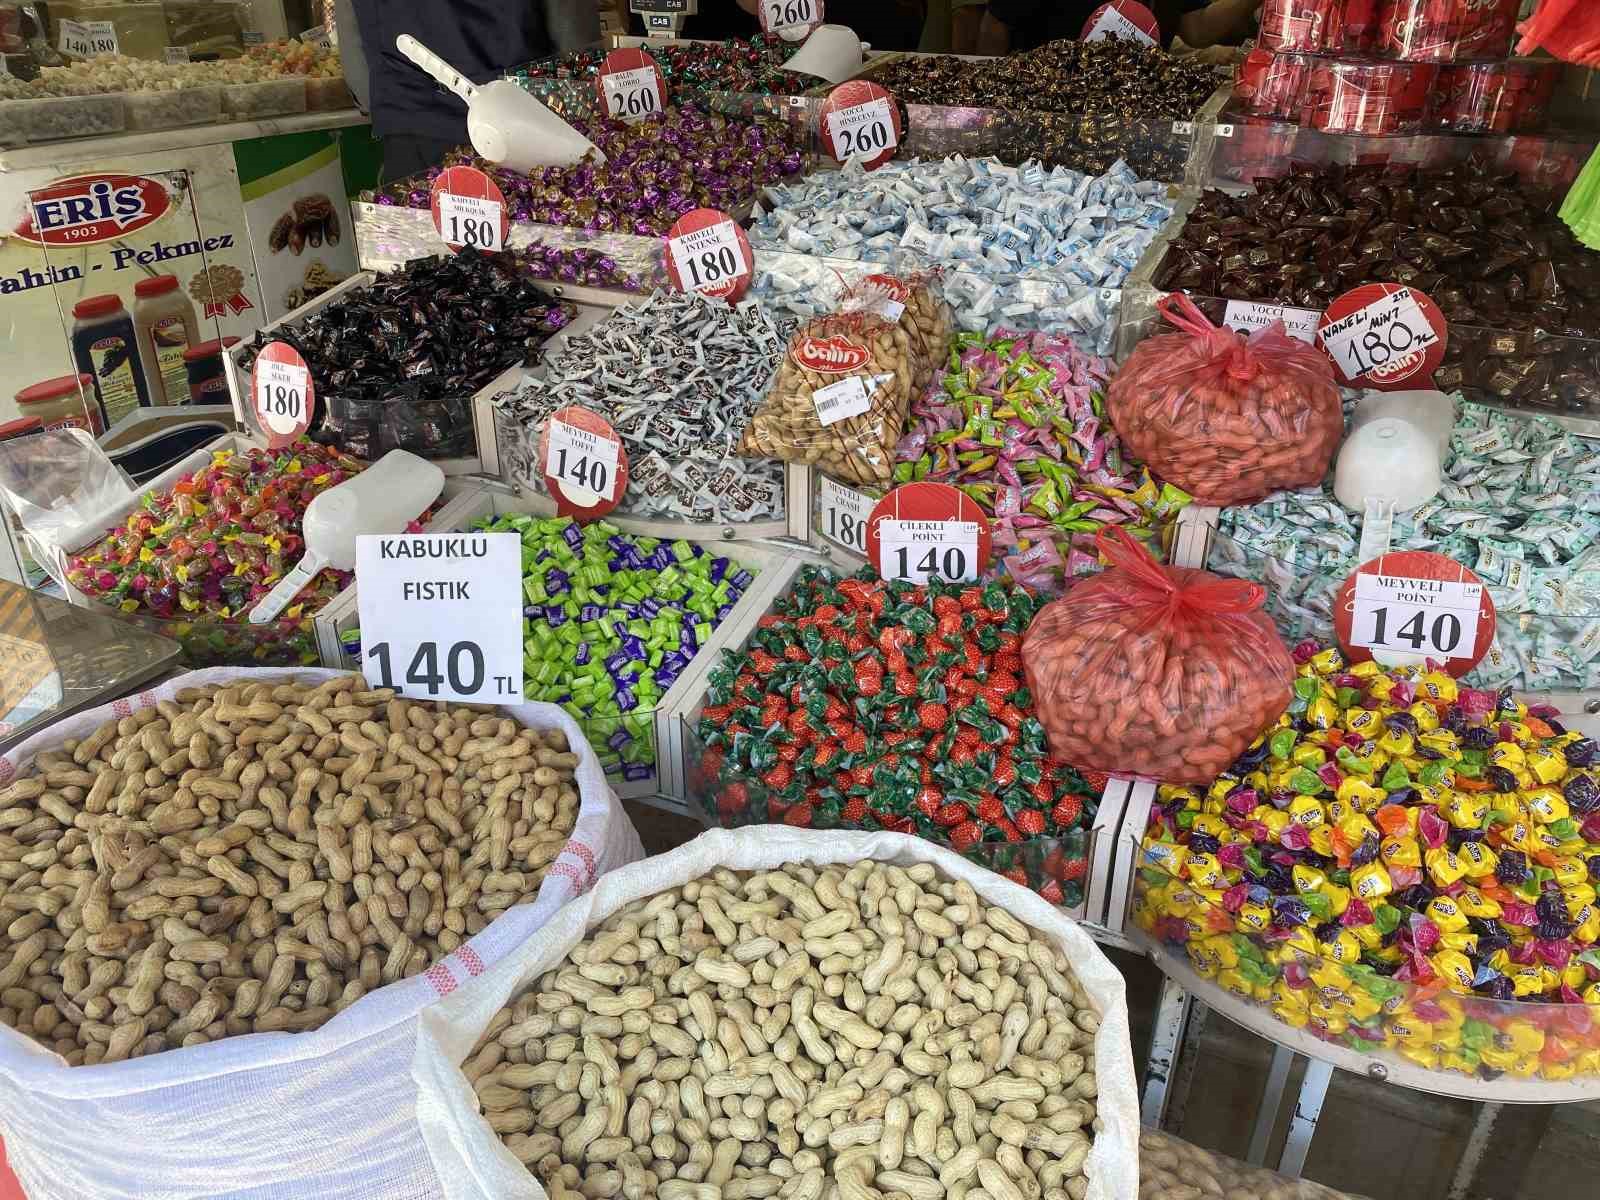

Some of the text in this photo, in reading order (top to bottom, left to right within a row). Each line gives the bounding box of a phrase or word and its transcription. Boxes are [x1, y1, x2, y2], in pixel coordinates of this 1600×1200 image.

[771, 0, 811, 27] 260
[612, 87, 654, 116] 260
[839, 121, 887, 156] 260
[63, 226, 99, 240] 1903
[450, 215, 494, 247] 180
[0, 266, 83, 295] ahin
[110, 234, 234, 271] Pekmez
[686, 246, 737, 286] 180
[1349, 321, 1413, 376] 180
[264, 383, 300, 418] 180
[556, 448, 607, 493] 140
[827, 507, 868, 551] 180
[380, 538, 487, 559] KABUKLU
[893, 546, 966, 580] 140
[403, 581, 470, 601] FISTIK
[1368, 607, 1461, 653] 140
[368, 640, 518, 695] 140 TL
